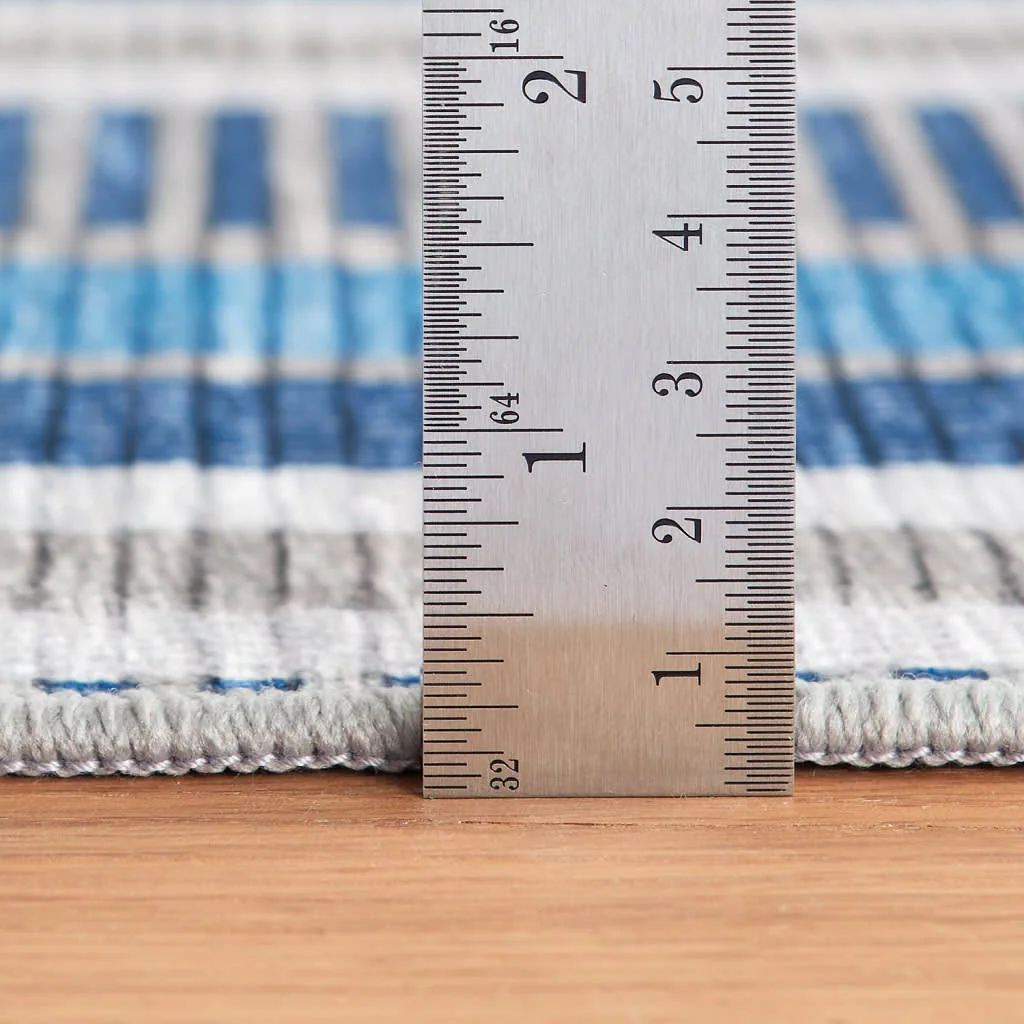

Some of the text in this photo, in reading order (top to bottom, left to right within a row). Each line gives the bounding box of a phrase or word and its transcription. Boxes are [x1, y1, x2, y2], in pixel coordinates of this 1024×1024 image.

[489, 18, 520, 53] 16
[521, 69, 587, 104] 2
[653, 77, 704, 104] 5
[652, 222, 703, 251] 4
[652, 371, 703, 398] 3
[489, 392, 520, 424] 64
[521, 441, 587, 474] 1
[651, 517, 702, 544] 2
[651, 662, 701, 686] 1
[489, 758, 519, 791] 32
